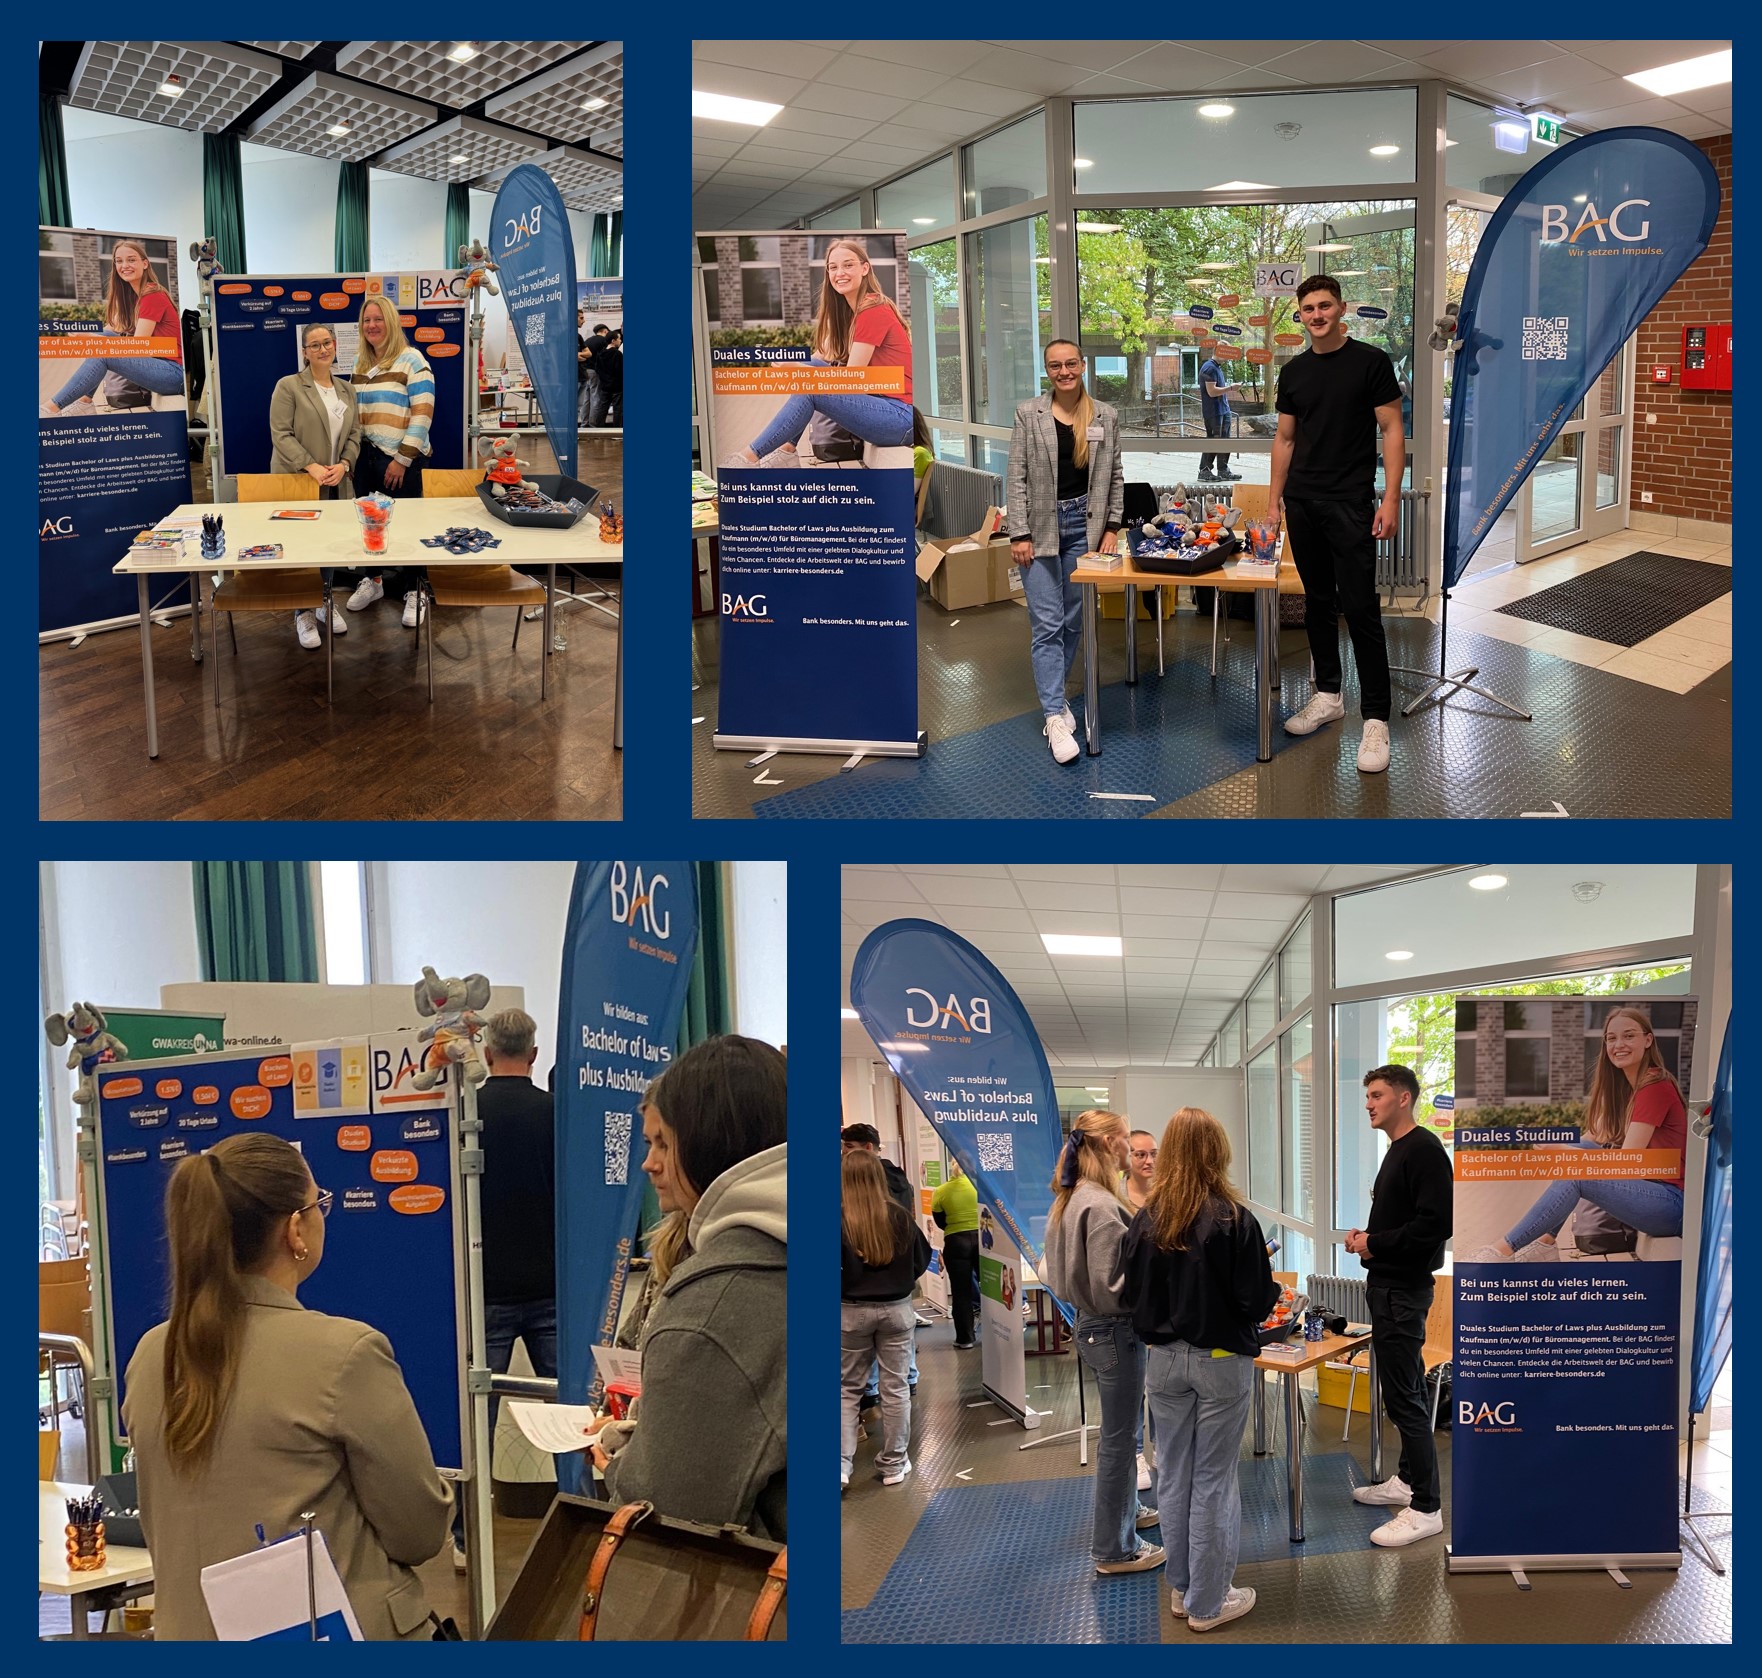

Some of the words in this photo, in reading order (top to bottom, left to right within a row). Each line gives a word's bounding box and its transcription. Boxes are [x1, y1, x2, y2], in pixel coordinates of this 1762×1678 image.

[1542, 200, 1650, 243] BAG
[1568, 248, 1584, 256] Wir
[1588, 248, 1618, 256] setzen
[1622, 247, 1664, 256] Impulse.
[1256, 270, 1295, 286] BAG
[53, 322, 98, 331] Studium
[714, 349, 750, 360] Duales
[755, 349, 806, 360] Studium
[752, 370, 762, 378] of
[792, 370, 810, 380] plus
[813, 370, 865, 379] Ausbildung
[716, 383, 757, 391] Kaufmann
[760, 383, 800, 391] (m/w/d)
[802, 382, 815, 390] für
[818, 383, 900, 392] Büromanagement
[43, 438, 75, 446] Beispiel
[78, 436, 97, 444] stolz
[1472, 516, 1488, 536] Bank
[1484, 473, 1518, 517] besonders.
[1514, 457, 1528, 472] Mit
[1526, 442, 1539, 458] uns
[1538, 419, 1553, 441] geht
[1551, 402, 1565, 420] das.
[750, 483, 782, 491] kannst
[785, 483, 797, 491] du
[800, 483, 826, 491] vieles
[828, 483, 858, 492] lernen.
[721, 495, 736, 503] Zum
[738, 496, 774, 505] Beispiel
[777, 495, 800, 503] stolz
[802, 495, 817, 503] auf
[819, 496, 838, 504] dich
[854, 496, 875, 504] sein.
[39, 516, 73, 536] AG
[722, 594, 767, 616] BAG
[611, 861, 670, 940] BAG
[603, 1002, 615, 1016] Wir
[616, 1004, 635, 1022] bilden
[636, 1012, 648, 1025] aus:
[224, 1036, 282, 1045] wa-online.de
[582, 1025, 628, 1056] Bachelor
[630, 1036, 640, 1057] of
[643, 1039, 671, 1062] Laws
[580, 1062, 603, 1090] plus
[414, 1120, 431, 1128] Bank
[404, 1129, 439, 1139] besonders
[1462, 1130, 1510, 1142] Duales
[1516, 1129, 1574, 1141] Studium
[1462, 1154, 1508, 1163] Bachelor
[1512, 1153, 1522, 1162] of
[1526, 1154, 1552, 1162] Laws
[1555, 1153, 1578, 1163] plus
[1582, 1152, 1642, 1162] Ausbildung
[1462, 1168, 1516, 1177] Kaufmann
[1520, 1167, 1563, 1177] (m/w/d)
[1567, 1166, 1583, 1175] für
[1586, 1167, 1676, 1176] Büromanagement
[343, 1200, 376, 1208] besonders
[1461, 1279, 1476, 1287] Bei
[1503, 1279, 1538, 1288] kannst
[1542, 1278, 1554, 1287] du
[1558, 1278, 1588, 1287] vieles
[1592, 1278, 1628, 1287] lernen.
[1460, 1292, 1484, 1301] Zum
[1488, 1292, 1528, 1303] Beispiel
[1532, 1292, 1557, 1301] stolz
[1560, 1292, 1578, 1300] auf
[1580, 1292, 1602, 1300] dich
[1622, 1292, 1647, 1300] sein.
[1586, 1324, 1602, 1332] plus
[1604, 1324, 1648, 1332] Ausbildung
[1459, 1401, 1515, 1425] BAG
[1644, 1424, 1660, 1432] geht
